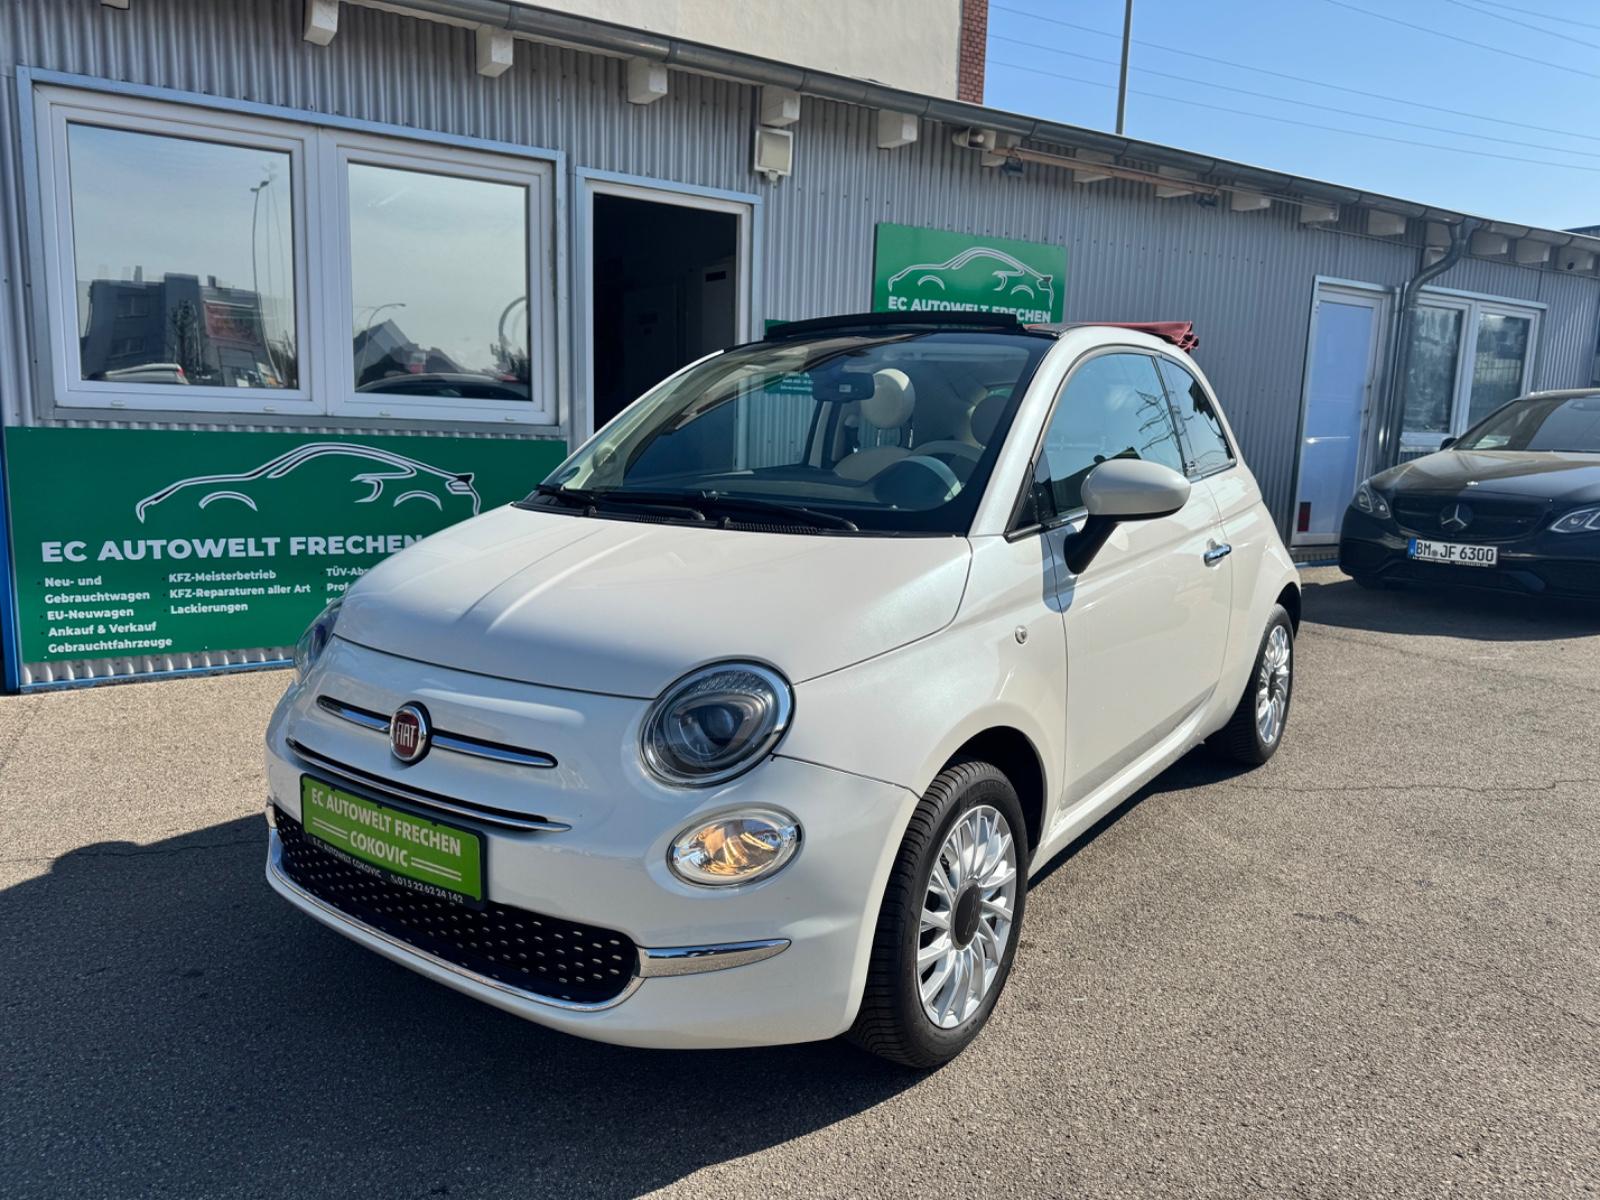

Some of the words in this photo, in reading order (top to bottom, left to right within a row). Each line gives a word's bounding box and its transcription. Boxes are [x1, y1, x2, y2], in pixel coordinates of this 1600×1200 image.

[888, 296, 907, 310] EC
[41, 541, 88, 562] EC
[97, 537, 281, 561] AUTOWELT
[1416, 542, 1431, 556] BM
[1440, 545, 1456, 558] JF
[1460, 547, 1494, 562] 6300
[44, 577, 74, 587] Neu-
[78, 576, 102, 586] und
[169, 569, 277, 583] KFZ-Meisterbetrieb
[169, 586, 265, 599] KFZ-Reparaturen
[267, 584, 291, 595] aller
[294, 584, 311, 594] Art
[326, 582, 350, 592] Prof
[44, 591, 150, 604] Gebrauchtwagen
[47, 608, 134, 621] EU-Neuwagen
[170, 603, 248, 615] Lackierungen
[48, 625, 94, 637] Ankauf
[97, 625, 106, 634] &
[109, 621, 157, 634] Verkauf
[48, 638, 172, 653] Gebrauchtfahrzeuge
[395, 721, 417, 748] FIAT
[311, 788, 324, 807] EC
[326, 796, 392, 833] AUTOWELT
[394, 819, 461, 857] FRECHEN
[350, 830, 408, 867] COKOVIC
